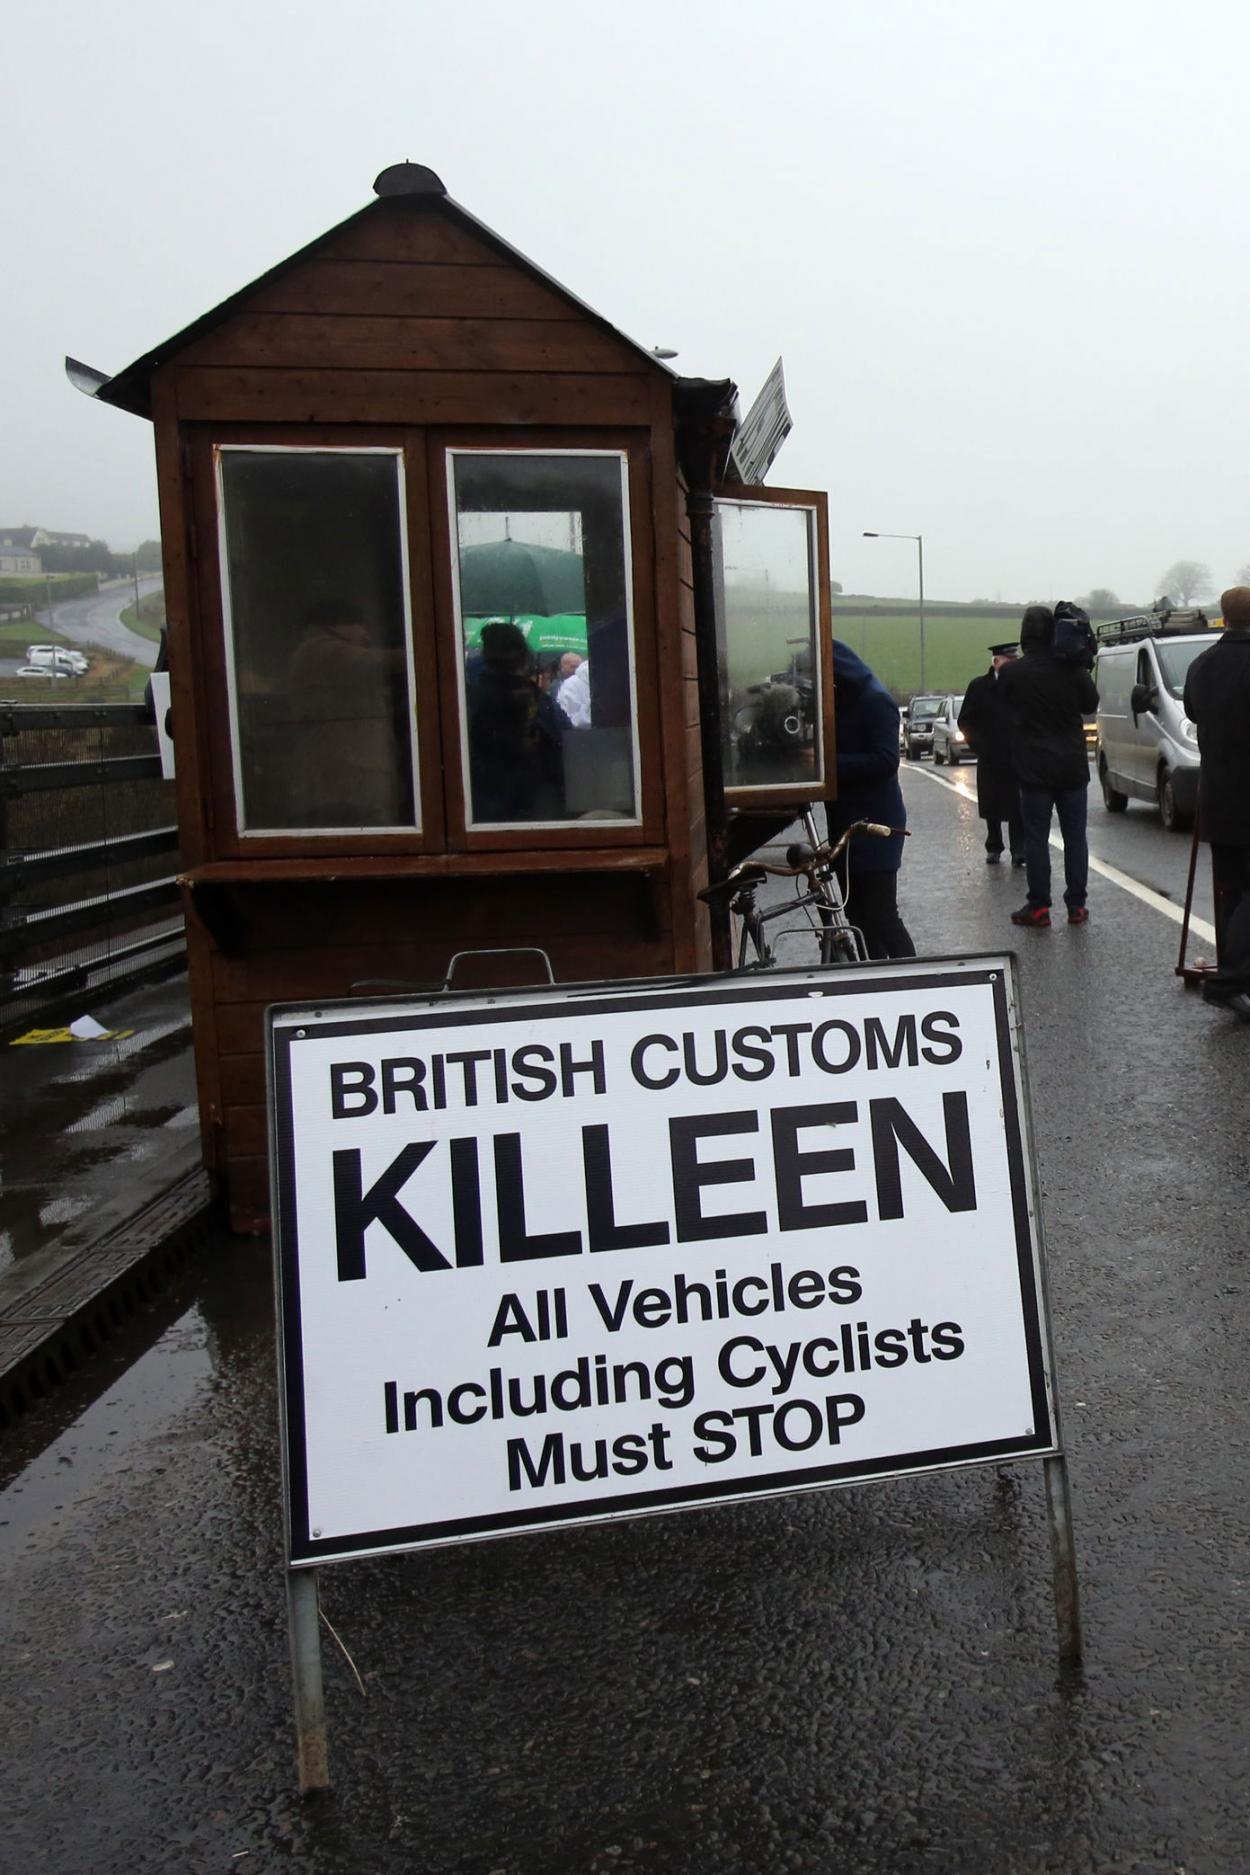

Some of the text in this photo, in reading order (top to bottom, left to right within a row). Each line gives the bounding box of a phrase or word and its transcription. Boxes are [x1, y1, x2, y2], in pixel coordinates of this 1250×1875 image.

[331, 1010, 963, 1120] BRITISH CUSTOMS
[332, 1090, 978, 1282] KILLEEN
[487, 1262, 863, 1347] All Vehicles
[384, 1317, 965, 1433] Including Cyclists
[506, 1393, 866, 1491] Must STOP
